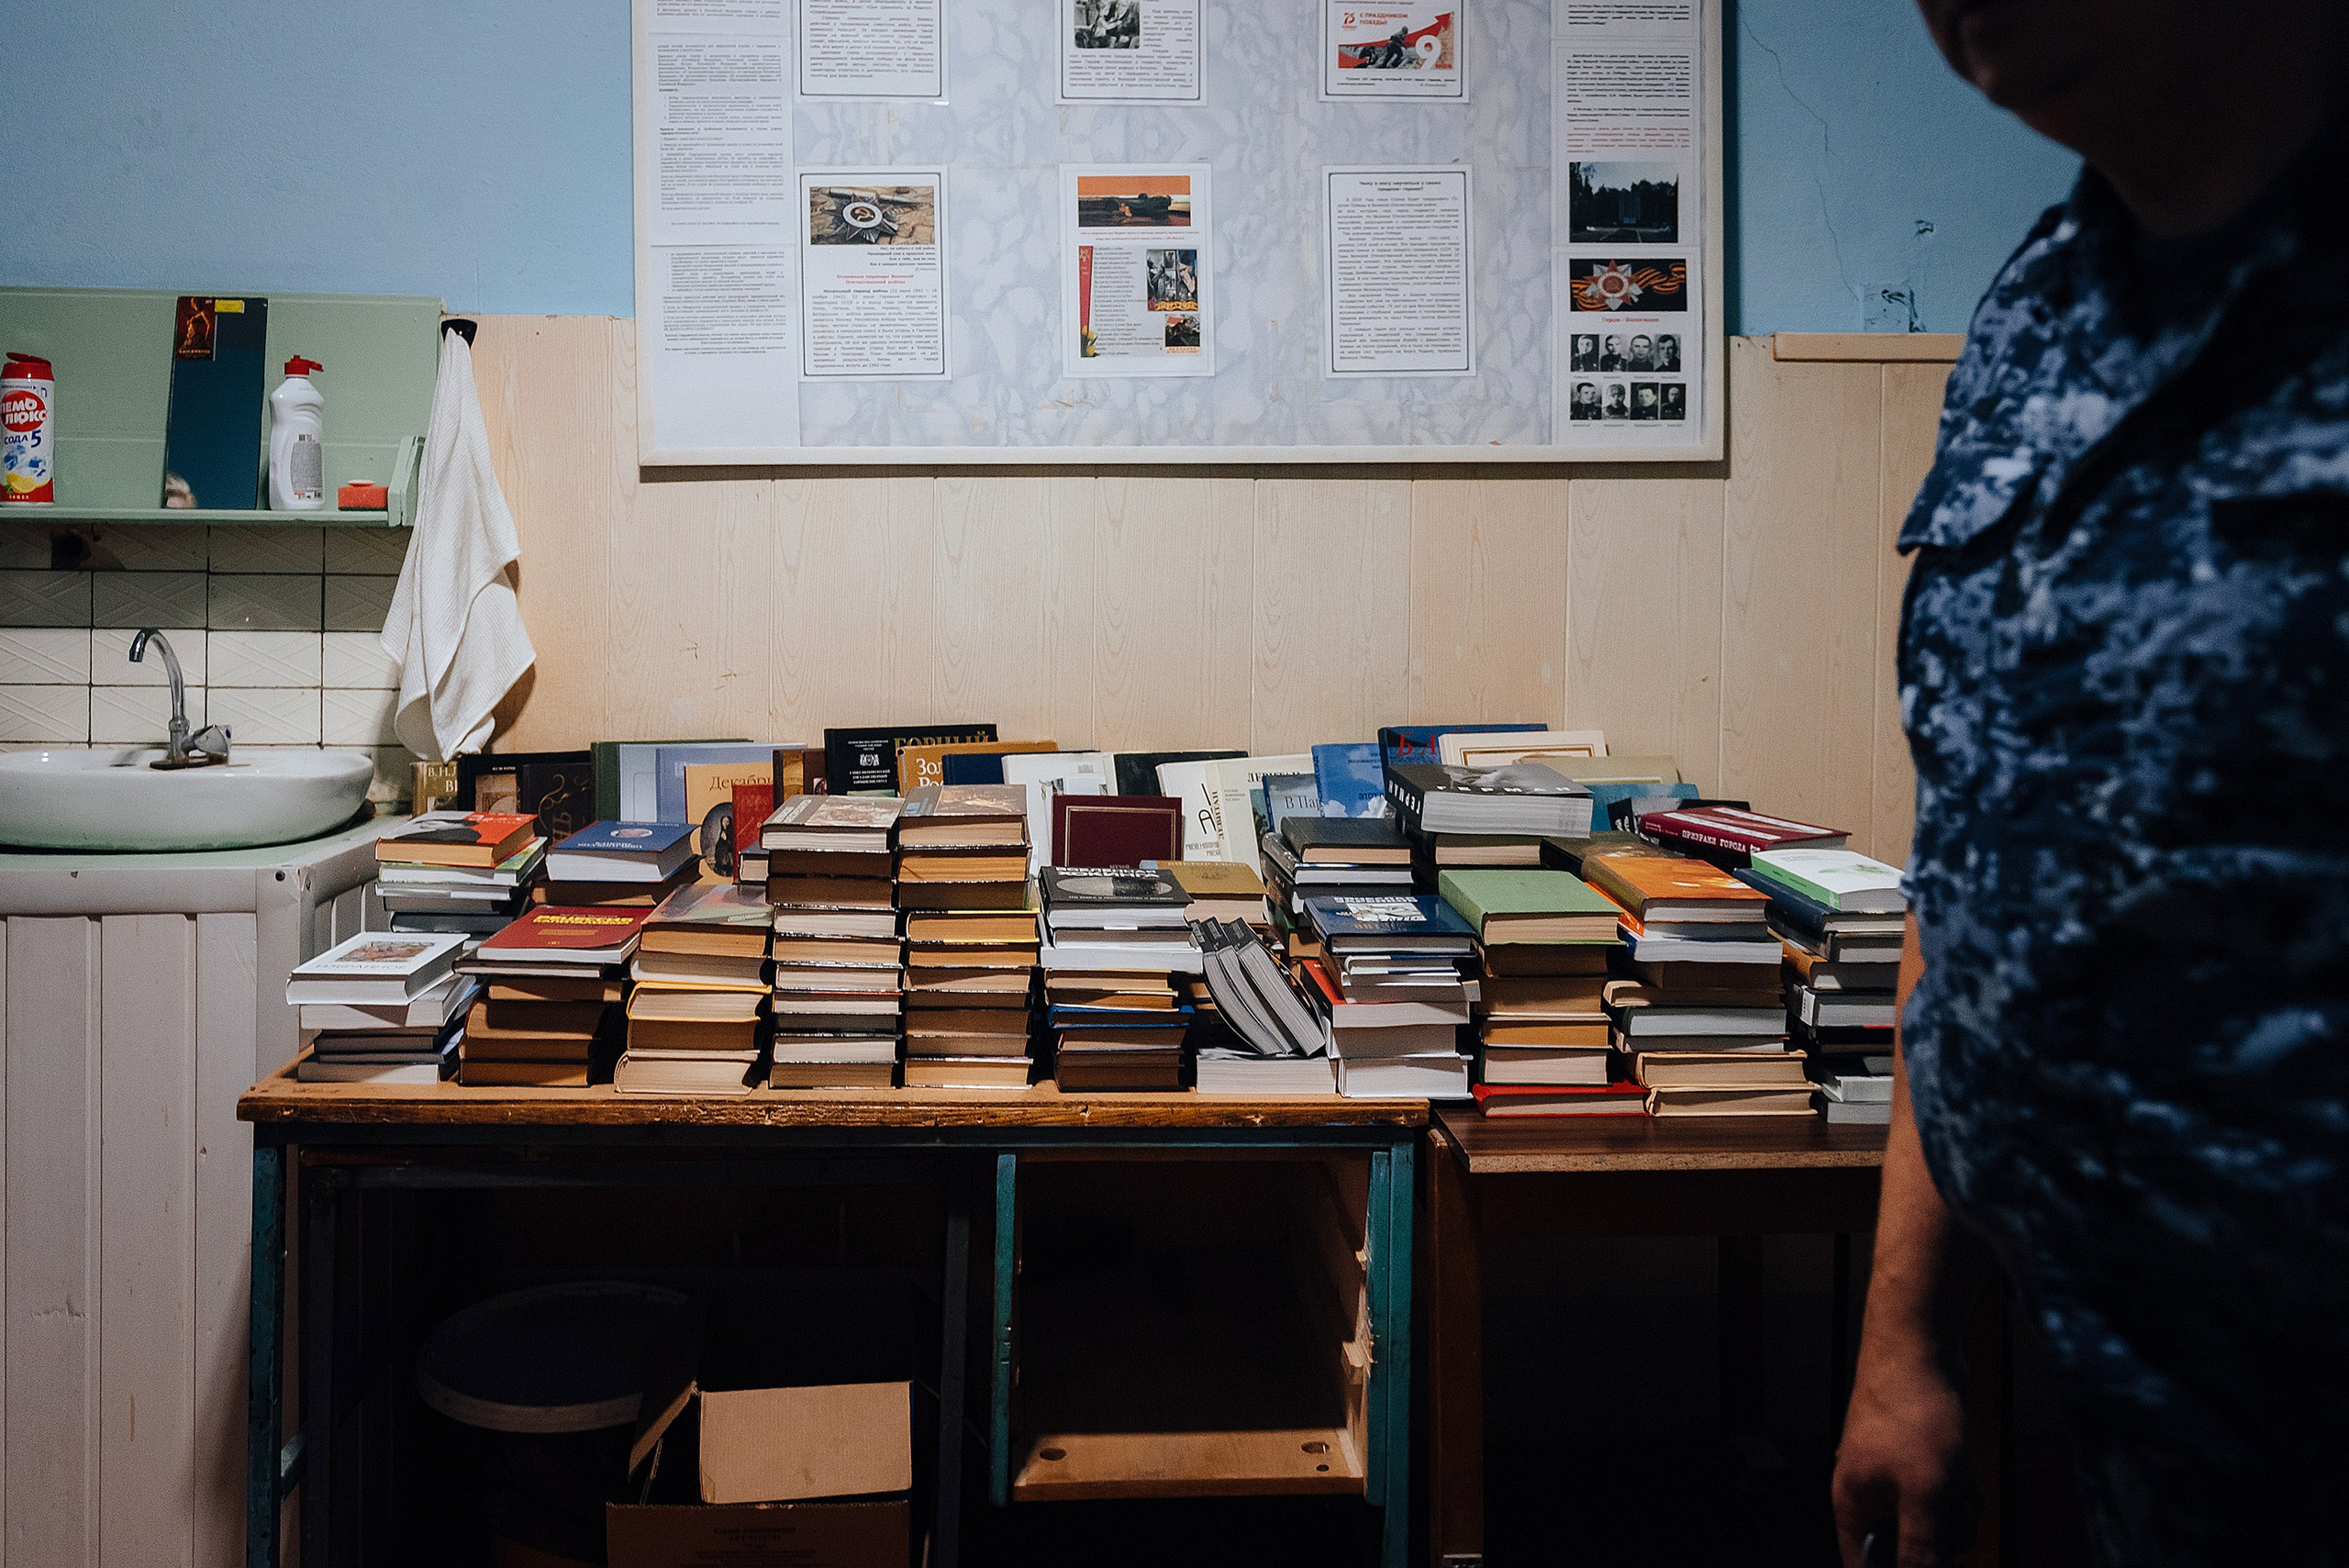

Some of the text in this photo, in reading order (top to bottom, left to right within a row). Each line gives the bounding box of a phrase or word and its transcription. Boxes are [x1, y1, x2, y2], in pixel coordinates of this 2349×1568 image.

[1416, 35, 1441, 69] 9
[5, 410, 47, 424] ЛЮКС
[31, 429, 41, 448] 5
[1285, 796, 1294, 809] В
[1388, 779, 1421, 815] ГЕРМАН
[1211, 791, 1224, 840] ЛЕВИТАН
[1682, 830, 1746, 852] ПРИЗРАКИ ГОРОДА
